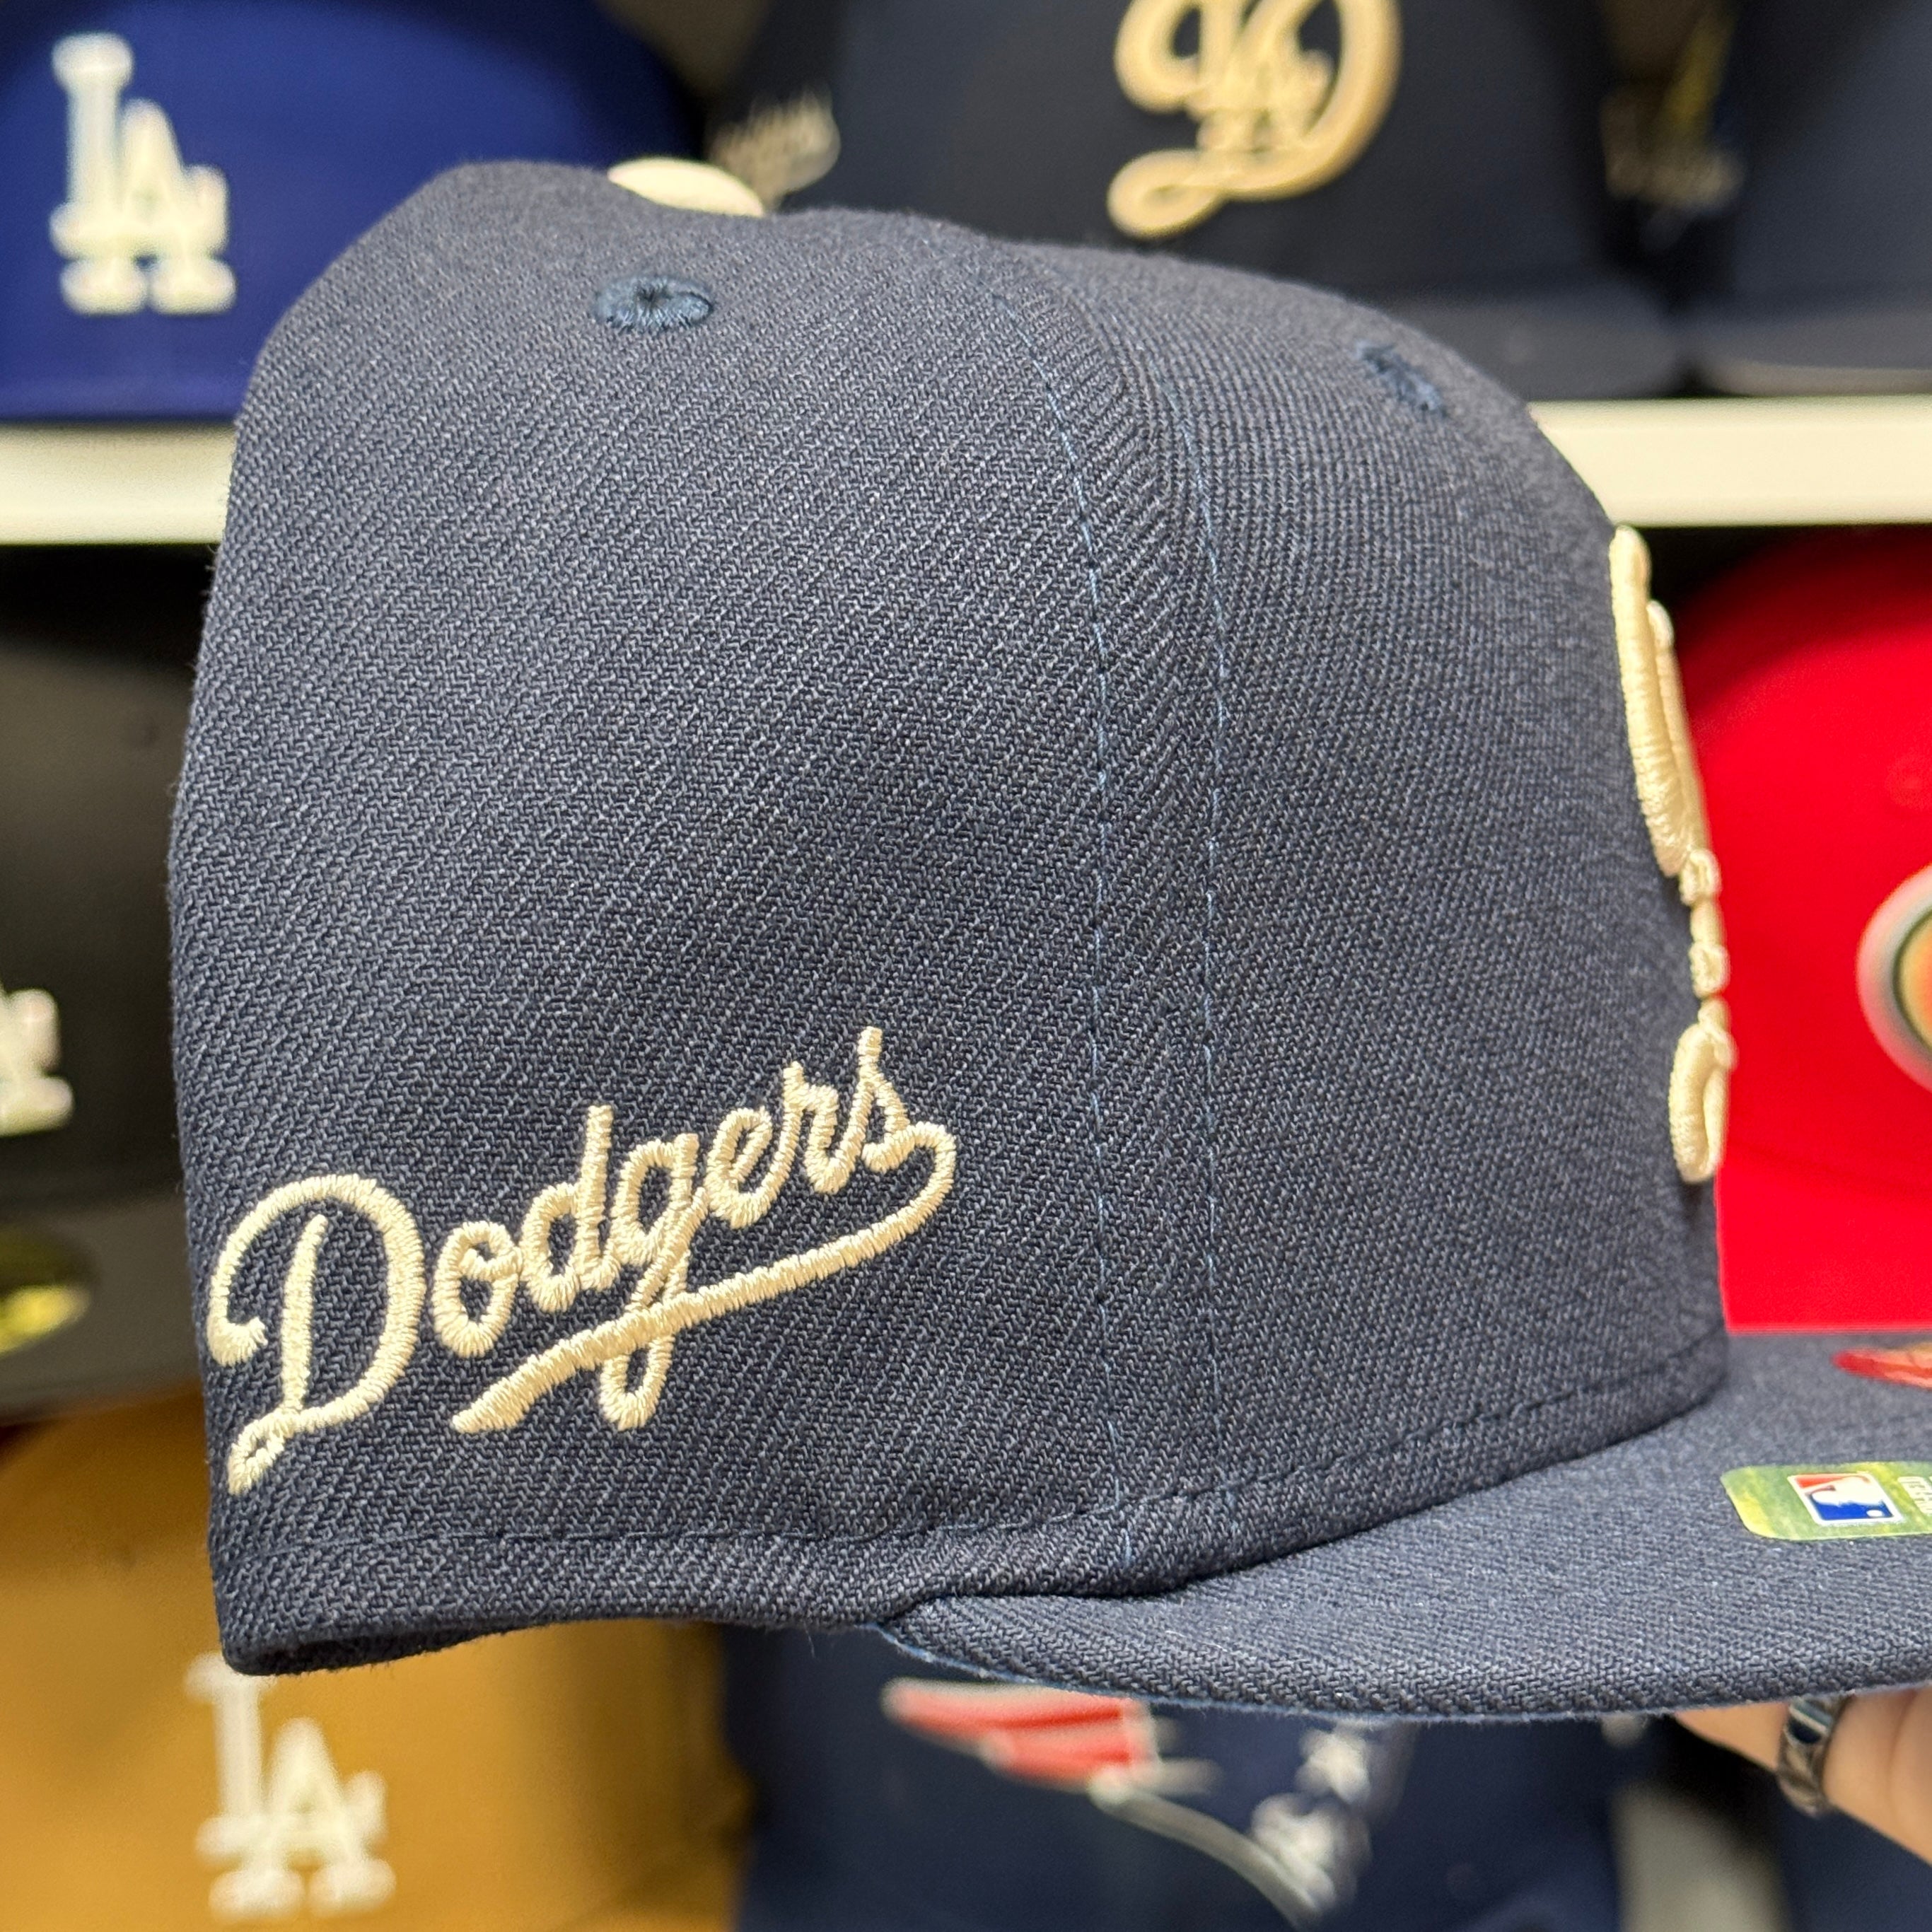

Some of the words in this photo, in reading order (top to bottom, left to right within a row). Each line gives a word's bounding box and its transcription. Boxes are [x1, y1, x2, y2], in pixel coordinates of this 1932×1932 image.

[52, 33, 236, 315] LA
[206, 1027, 956, 1494] Dodgers
[184, 1651, 396, 1916] LA
